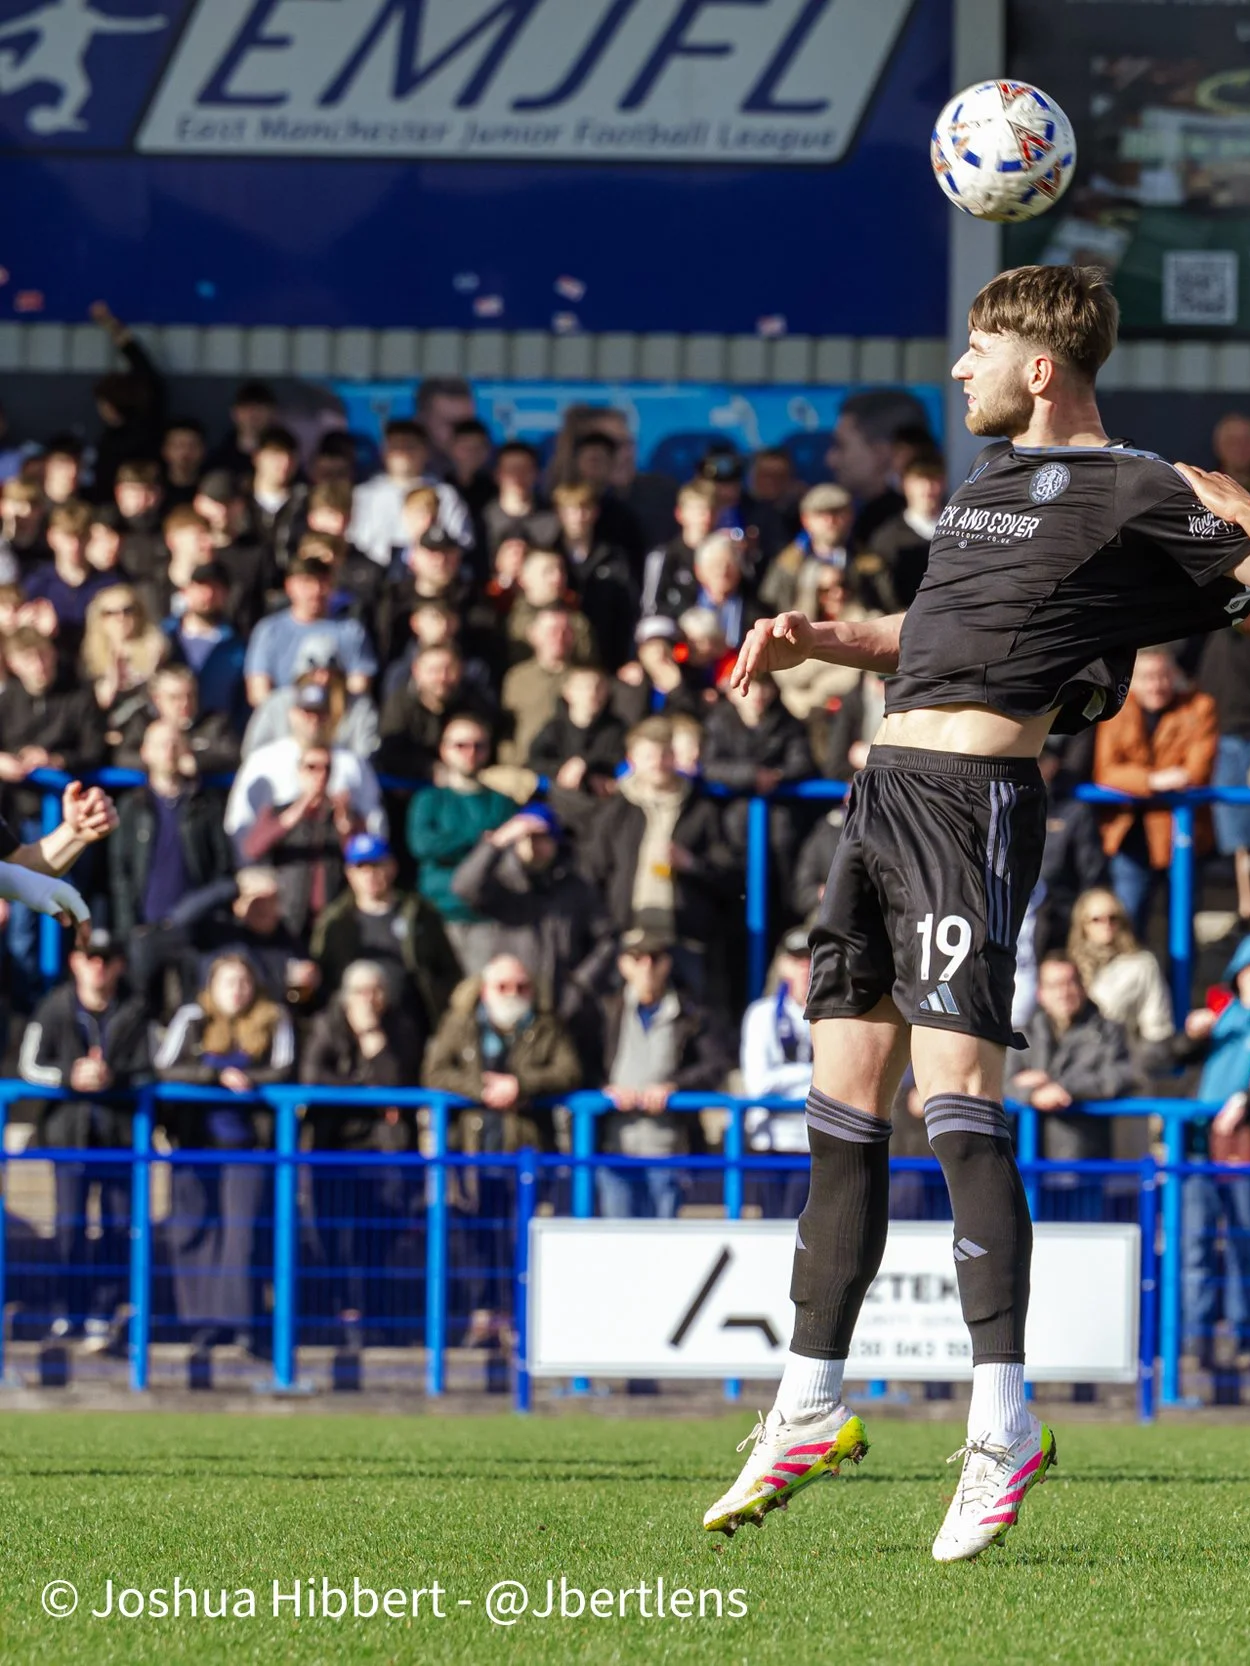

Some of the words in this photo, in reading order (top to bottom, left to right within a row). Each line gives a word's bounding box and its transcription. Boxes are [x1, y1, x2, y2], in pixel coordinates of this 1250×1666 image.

[195, 0, 833, 116] EMJFL
[176, 115, 246, 142] East
[260, 115, 447, 144] Manchester
[459, 118, 563, 150] Junior
[575, 118, 709, 147] Football
[717, 119, 835, 155] League
[955, 507, 990, 531] AND
[987, 512, 1040, 538] COVER
[916, 912, 973, 982] 19
